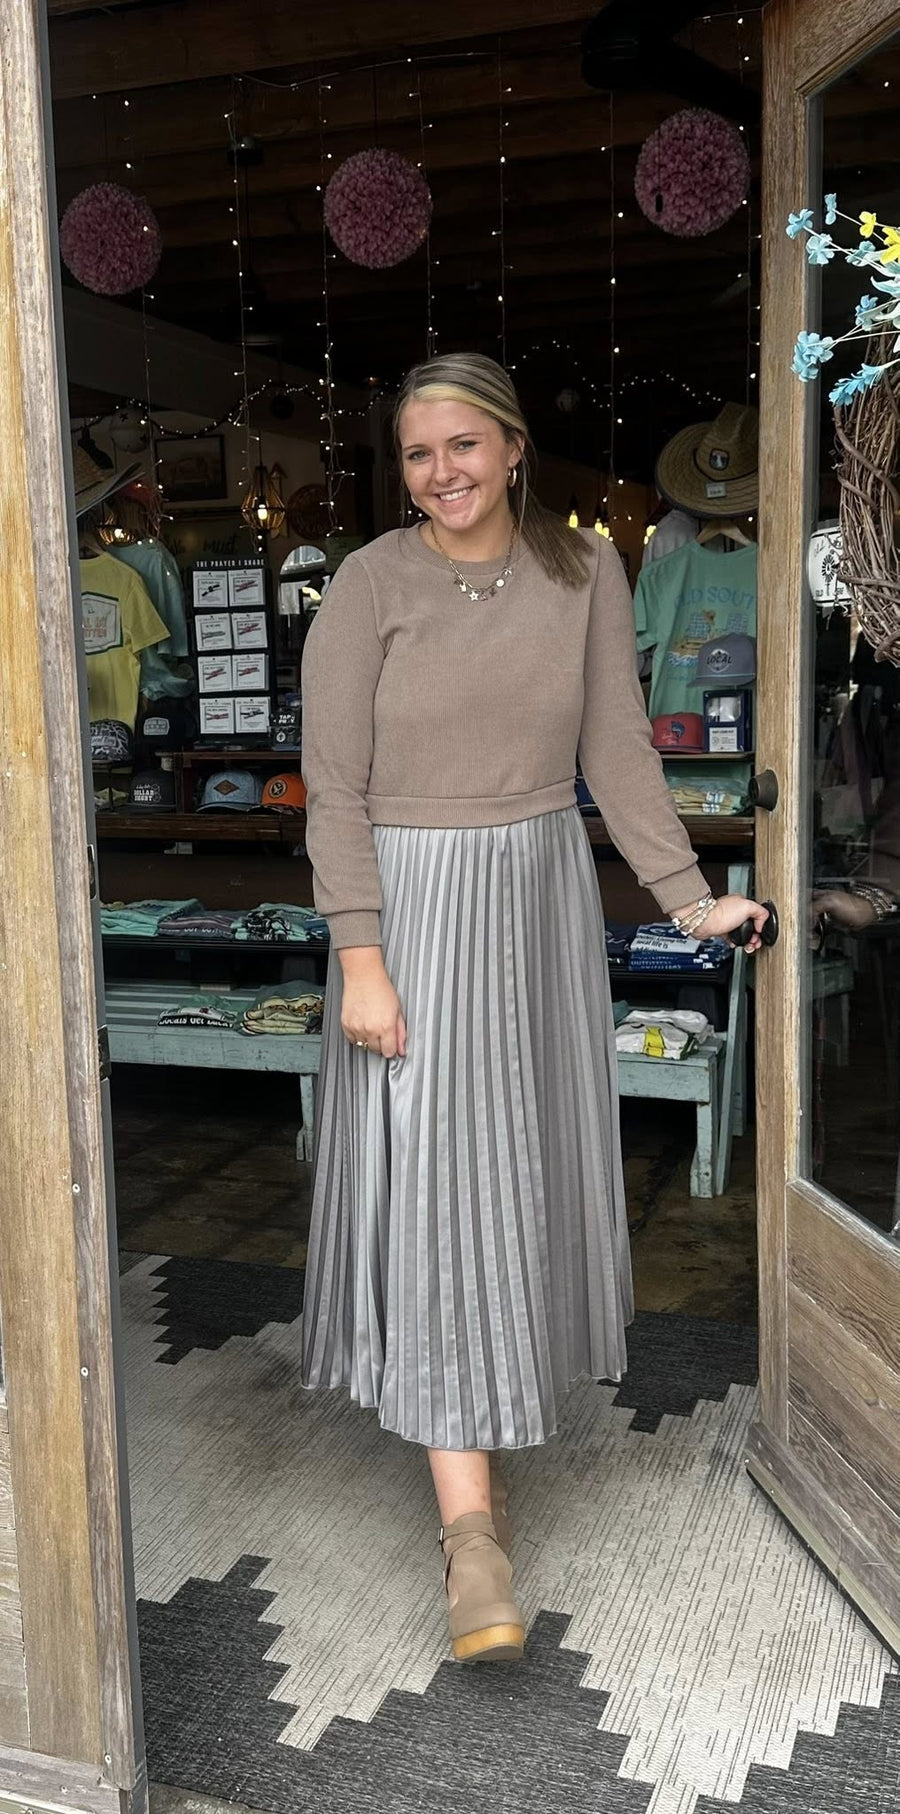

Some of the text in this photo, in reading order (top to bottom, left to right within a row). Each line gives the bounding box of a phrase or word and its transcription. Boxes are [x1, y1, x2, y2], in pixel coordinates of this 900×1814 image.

[210, 559, 236, 567] PRAYER
[244, 558, 265, 566] SHARE
[706, 586, 755, 610] SOUT
[706, 654, 734, 665] LOCAL
[652, 940, 663, 948] life
